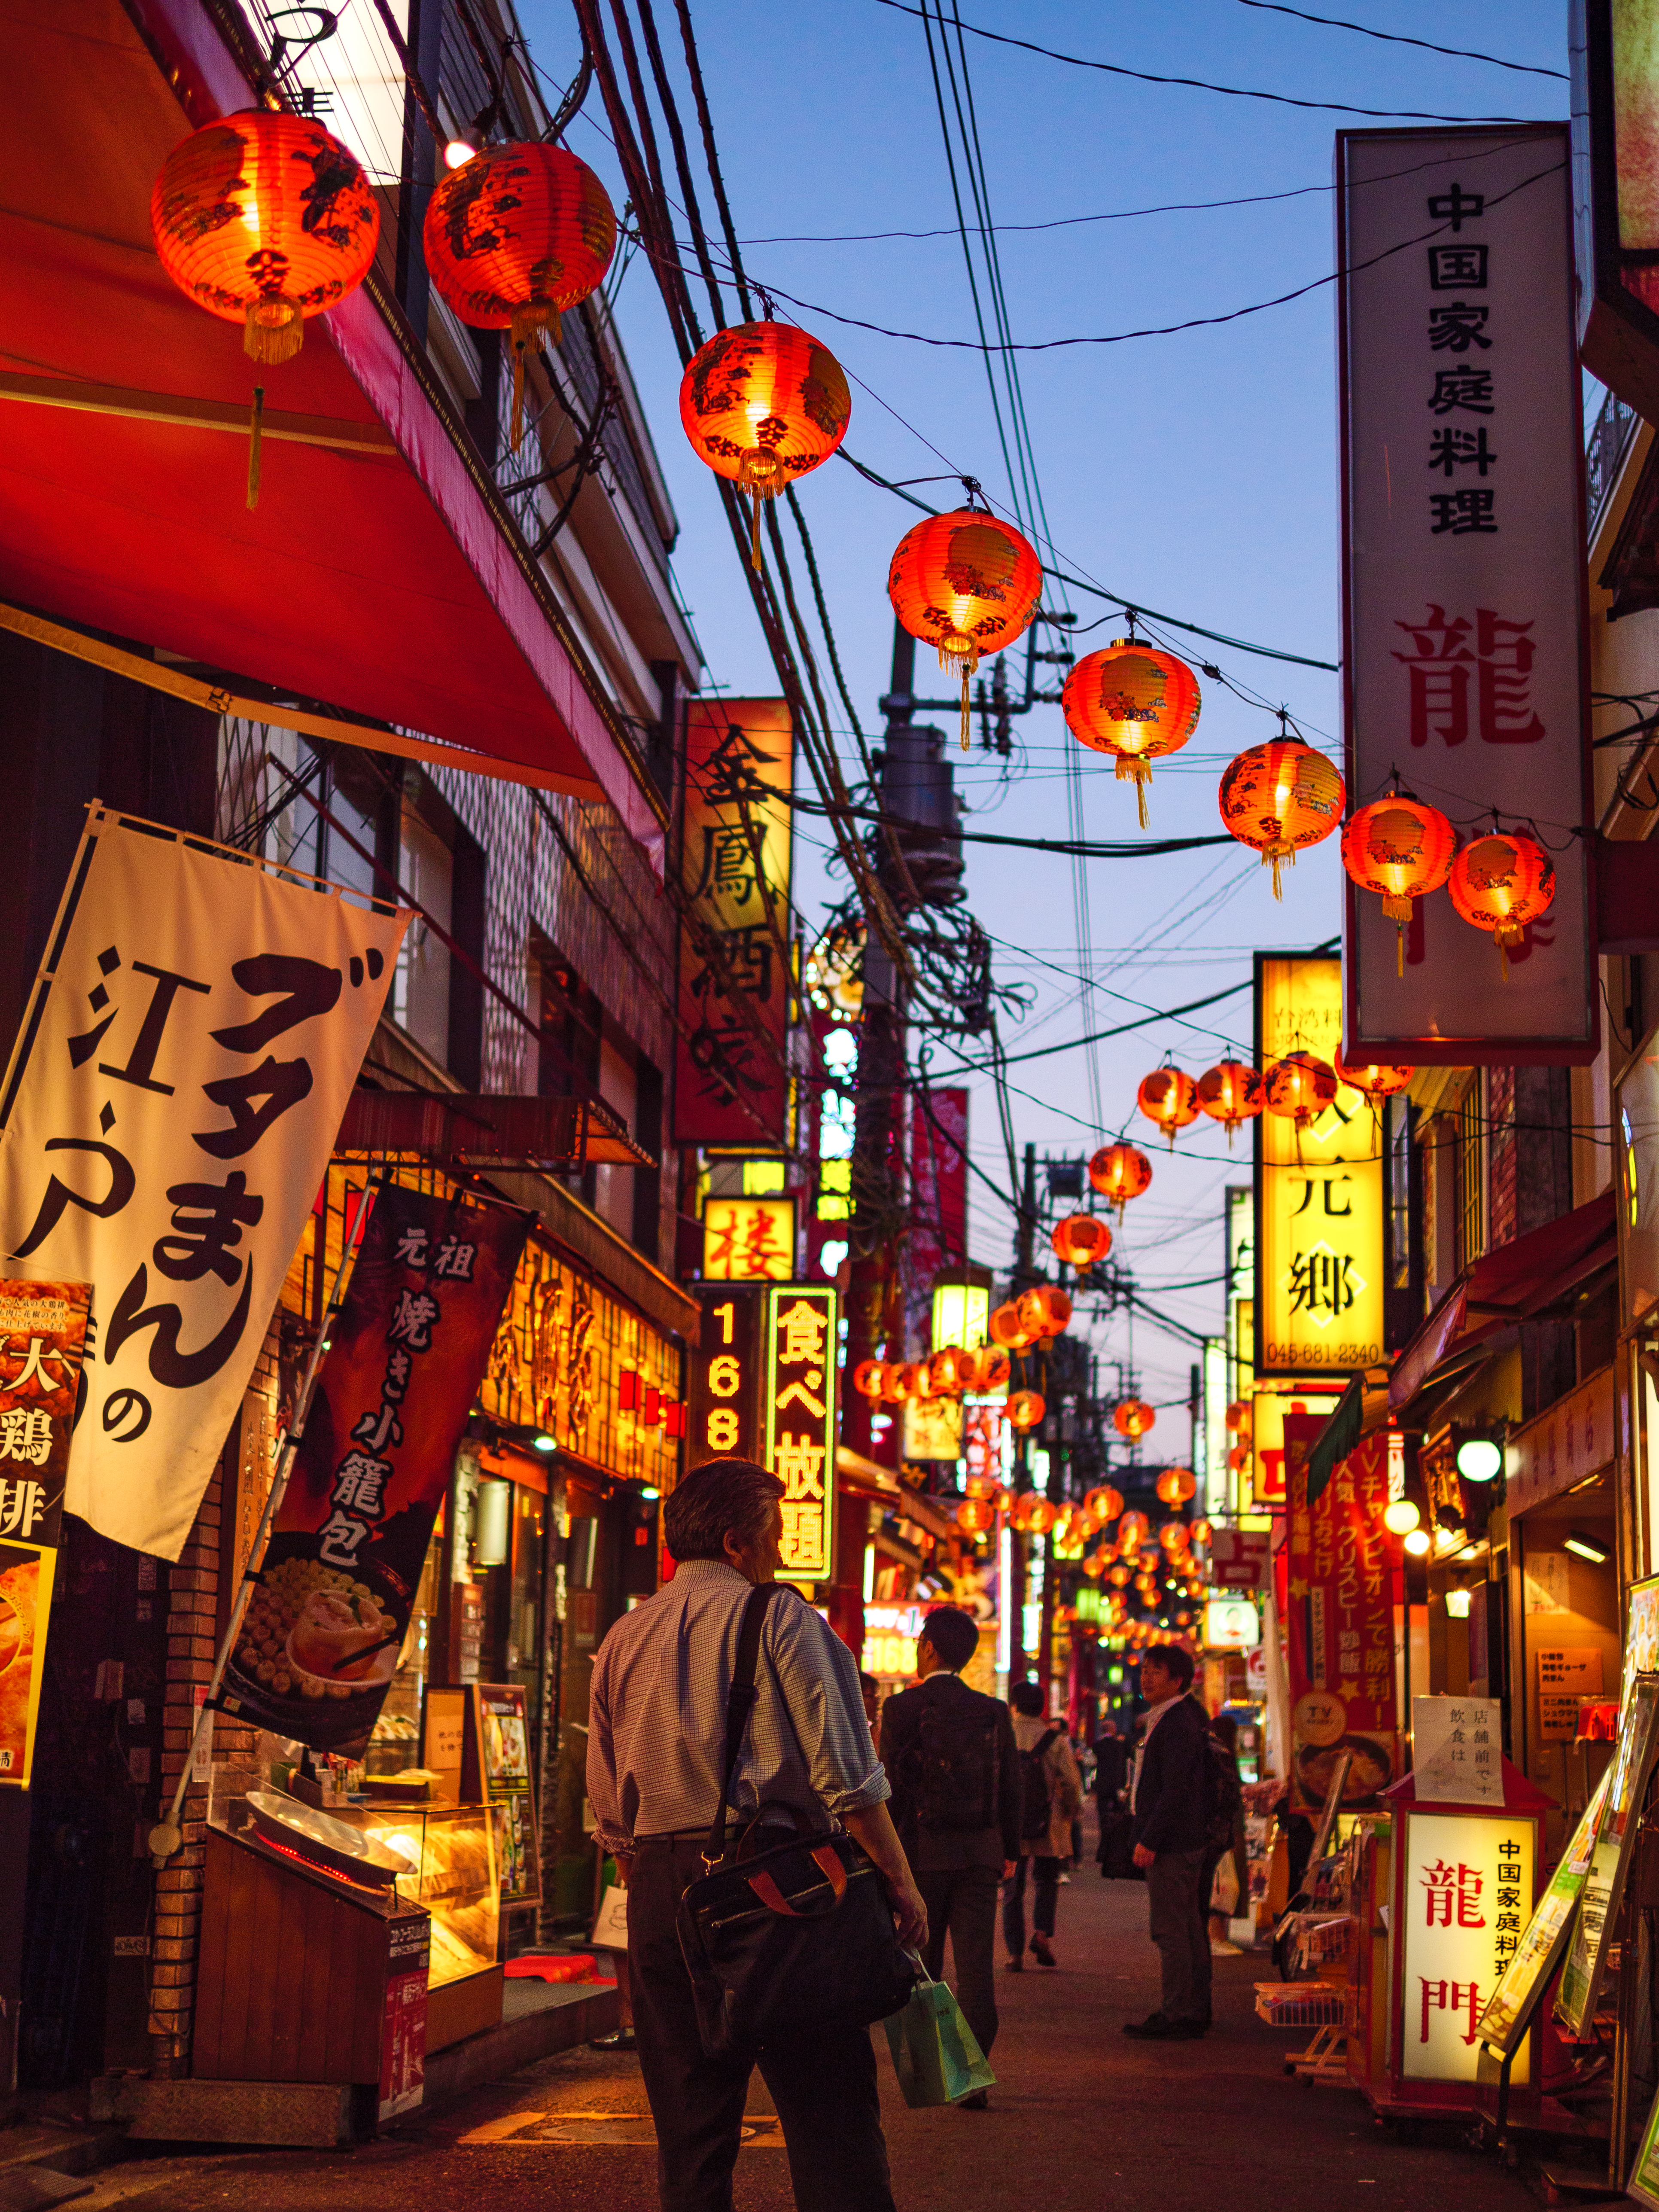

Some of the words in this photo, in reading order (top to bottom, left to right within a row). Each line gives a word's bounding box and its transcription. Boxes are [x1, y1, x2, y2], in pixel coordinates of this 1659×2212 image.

[1427, 183, 1498, 535] 中国家庭料理
[105, 948, 384, 1388] ブタまん
[394, 1228, 475, 1279] 元祖
[1288, 1101, 1355, 1317] 元郷
[319, 1290, 436, 1567] 焼き小籠包
[708, 1303, 740, 1451] 168
[776, 1301, 828, 1568] 食べ放題
[1266, 1343, 1380, 1365] 045-681-2340
[1450, 1708, 1467, 1762] 飲食は
[1473, 1709, 1492, 1796] 店舗前です
[1418, 1858, 1488, 2046] 龍門
